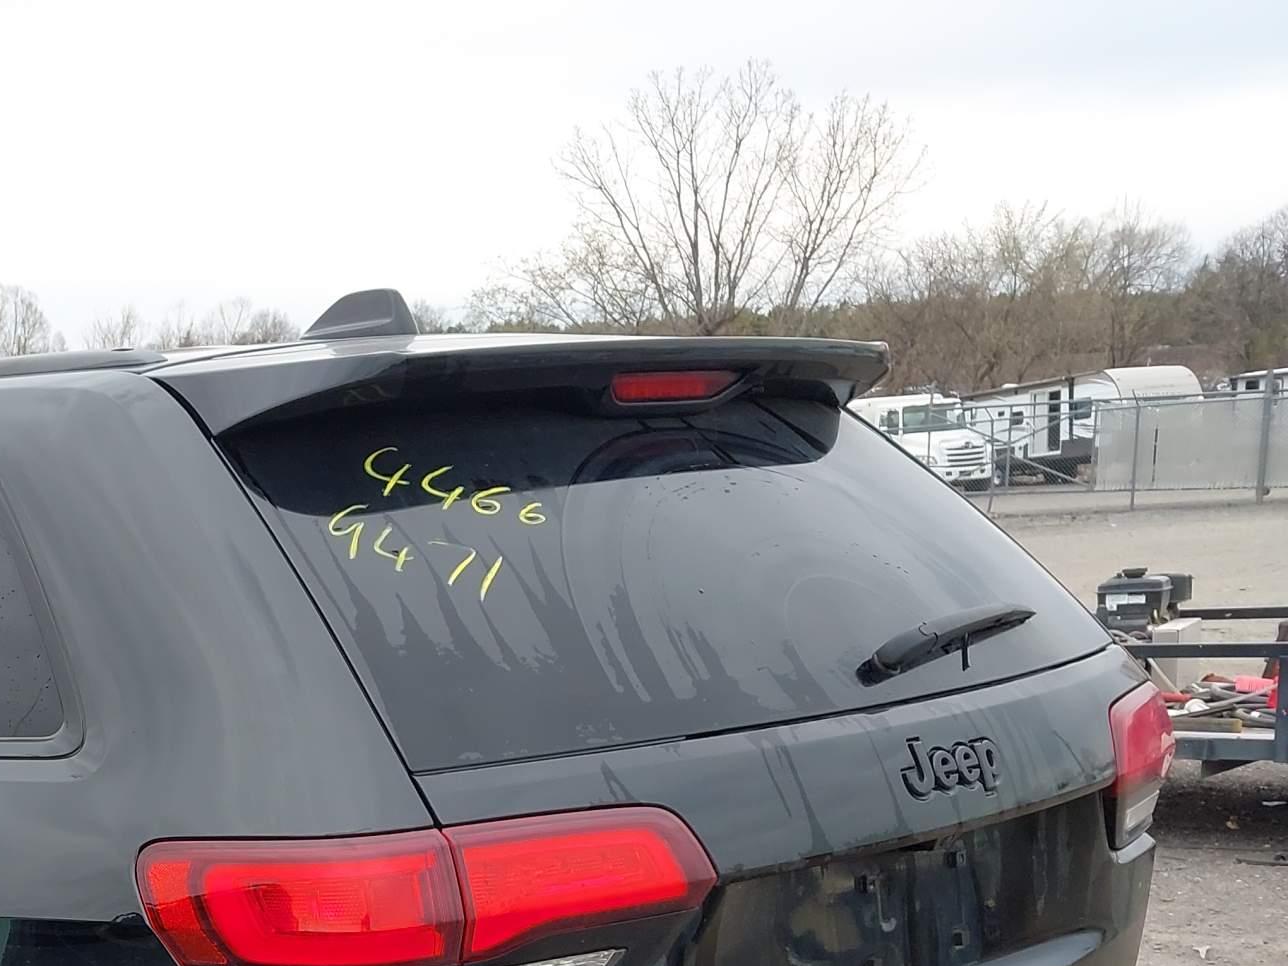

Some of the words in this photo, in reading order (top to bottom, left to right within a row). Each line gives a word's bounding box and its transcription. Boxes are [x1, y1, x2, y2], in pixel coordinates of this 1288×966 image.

[363, 446, 547, 525] 4466
[327, 504, 504, 602] 9471
[899, 735, 1001, 802] Jeep
